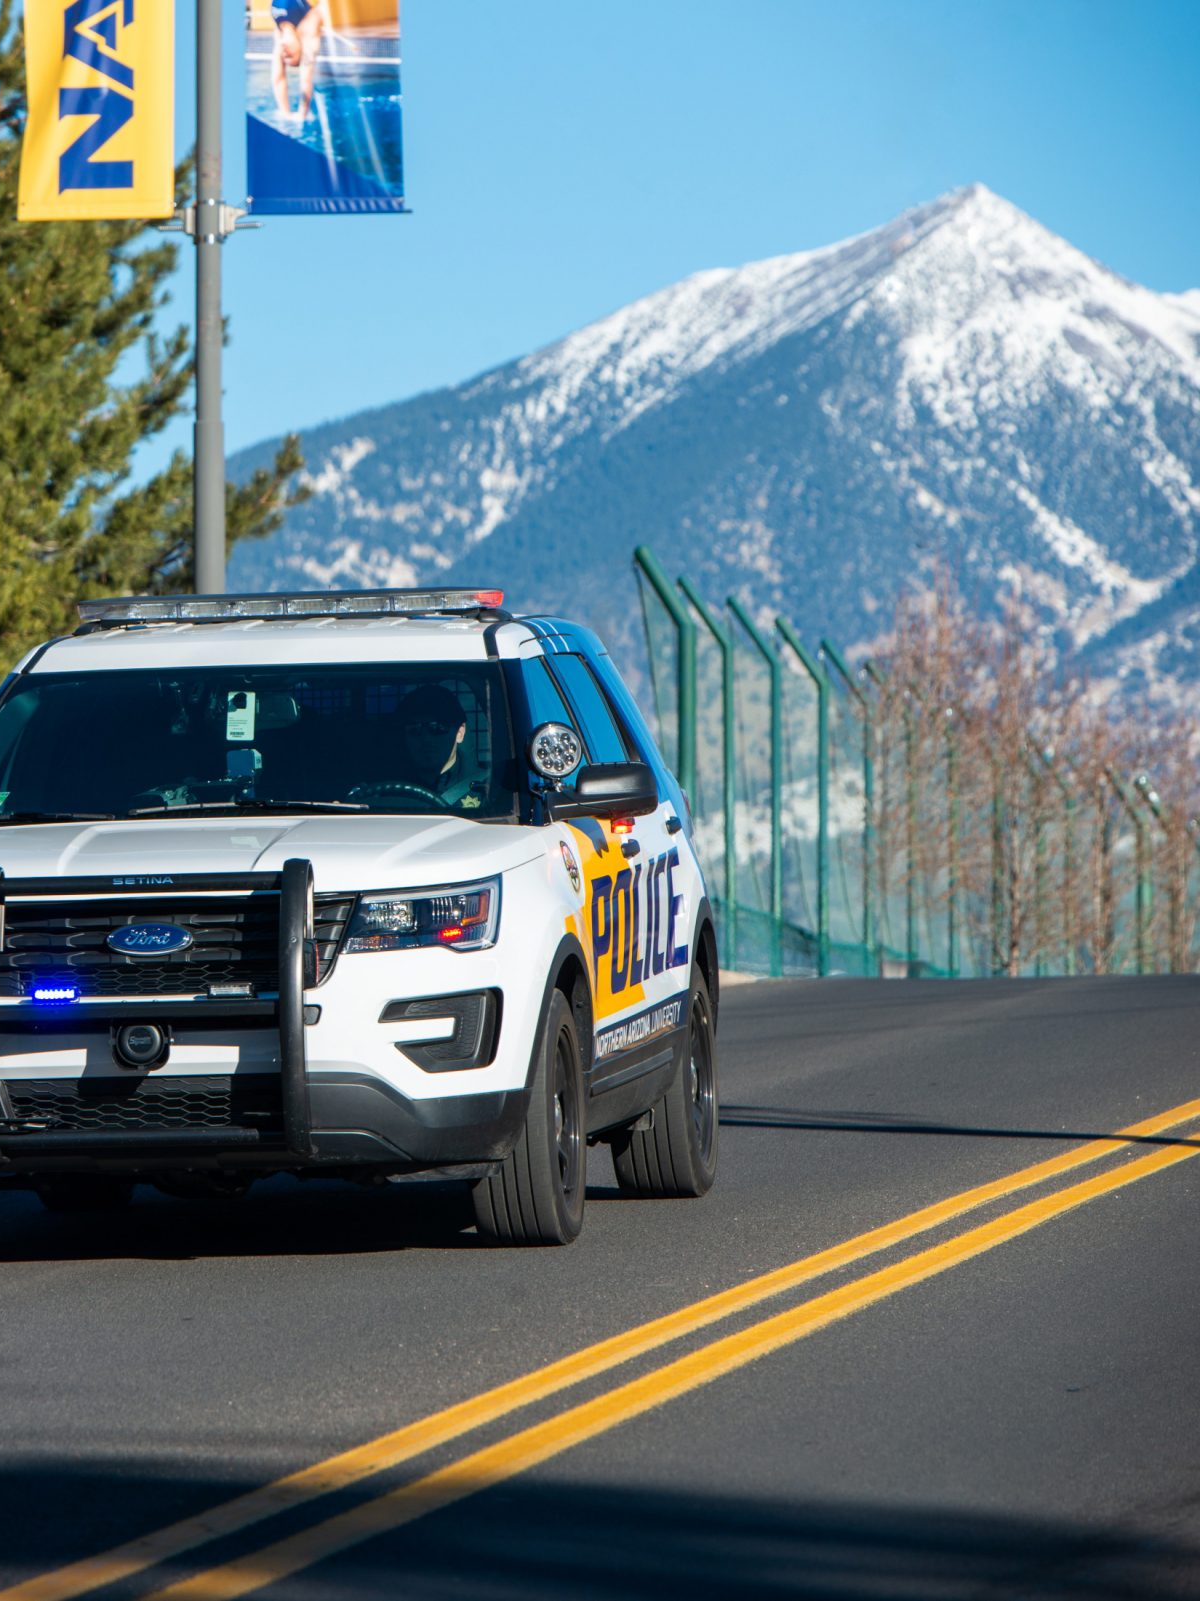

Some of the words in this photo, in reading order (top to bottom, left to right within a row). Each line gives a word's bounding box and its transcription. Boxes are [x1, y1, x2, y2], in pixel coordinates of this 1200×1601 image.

[112, 876, 174, 886] SETINA
[125, 929, 170, 946] Ford
[591, 846, 689, 995] POLICE
[596, 1024, 628, 1058] NORTHERN
[627, 1013, 651, 1046] ARIZONA
[652, 1000, 682, 1034] UNIVERSITY
